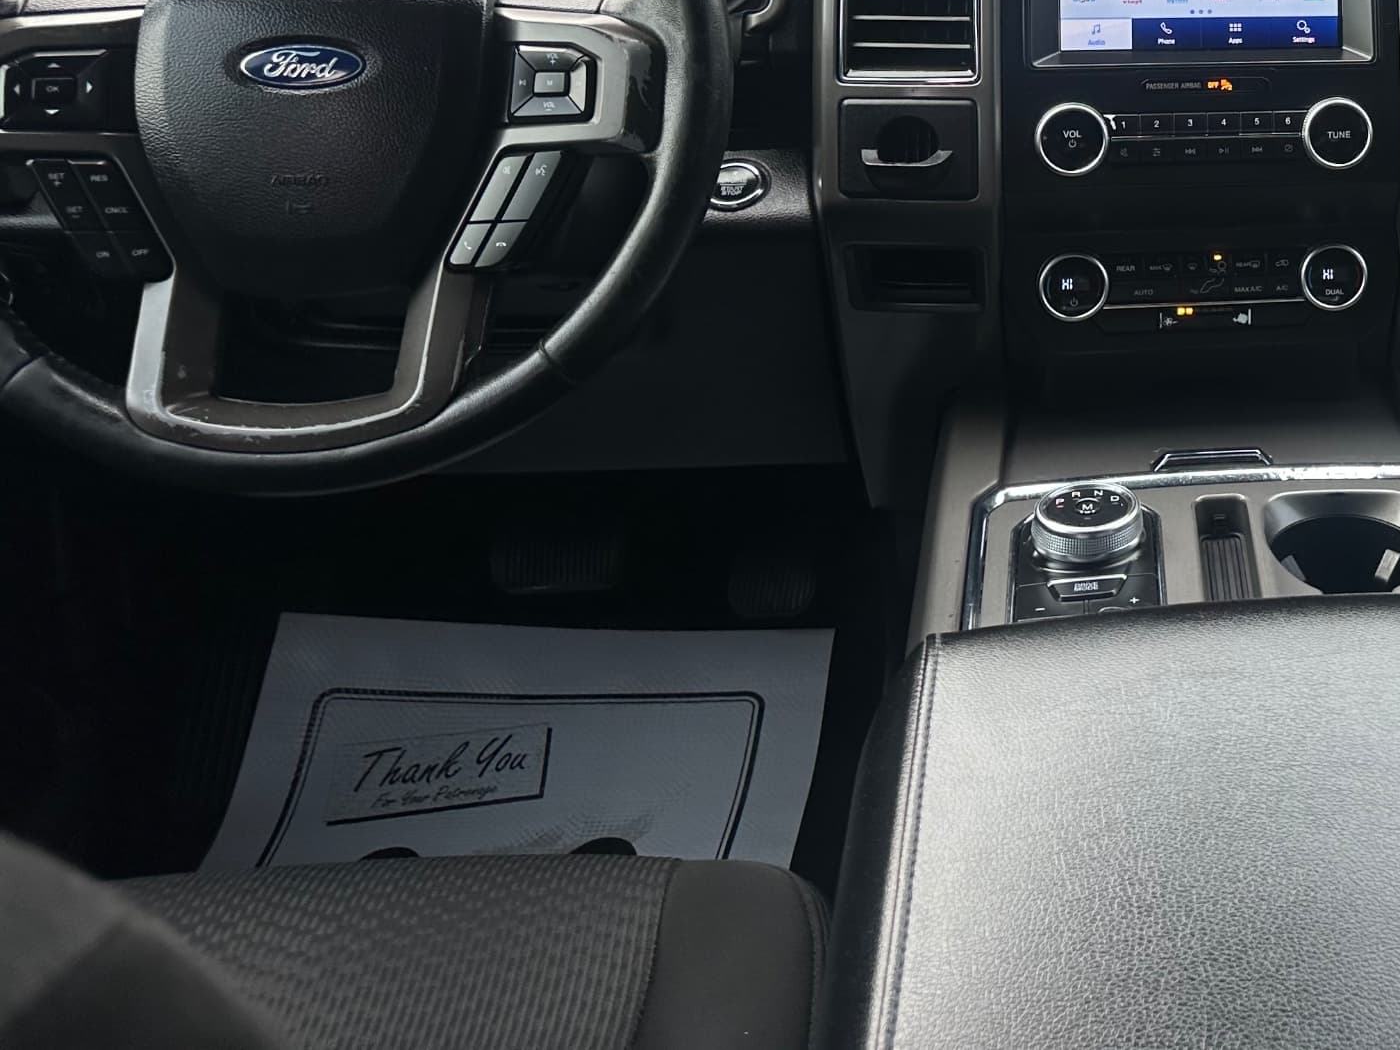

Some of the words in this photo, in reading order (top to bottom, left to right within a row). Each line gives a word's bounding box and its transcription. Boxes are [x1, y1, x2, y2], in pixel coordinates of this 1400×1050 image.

[1157, 37, 1176, 45] Phone
[1228, 37, 1243, 45] Apps
[1292, 36, 1315, 44] Settings
[263, 49, 339, 78] Ford
[1153, 120, 1160, 128] 2
[1187, 119, 1193, 127] 3
[1220, 118, 1227, 126] 4
[1254, 118, 1260, 126] 5
[1285, 117, 1291, 125] 6
[1062, 129, 1082, 139] VOL
[1327, 130, 1351, 140] TUNE
[1322, 268, 1334, 281] HI
[1061, 278, 1074, 291] HI
[1325, 287, 1345, 296] DUAL
[1082, 503, 1094, 511] M
[353, 740, 470, 793] Thank
[475, 733, 528, 778] You
